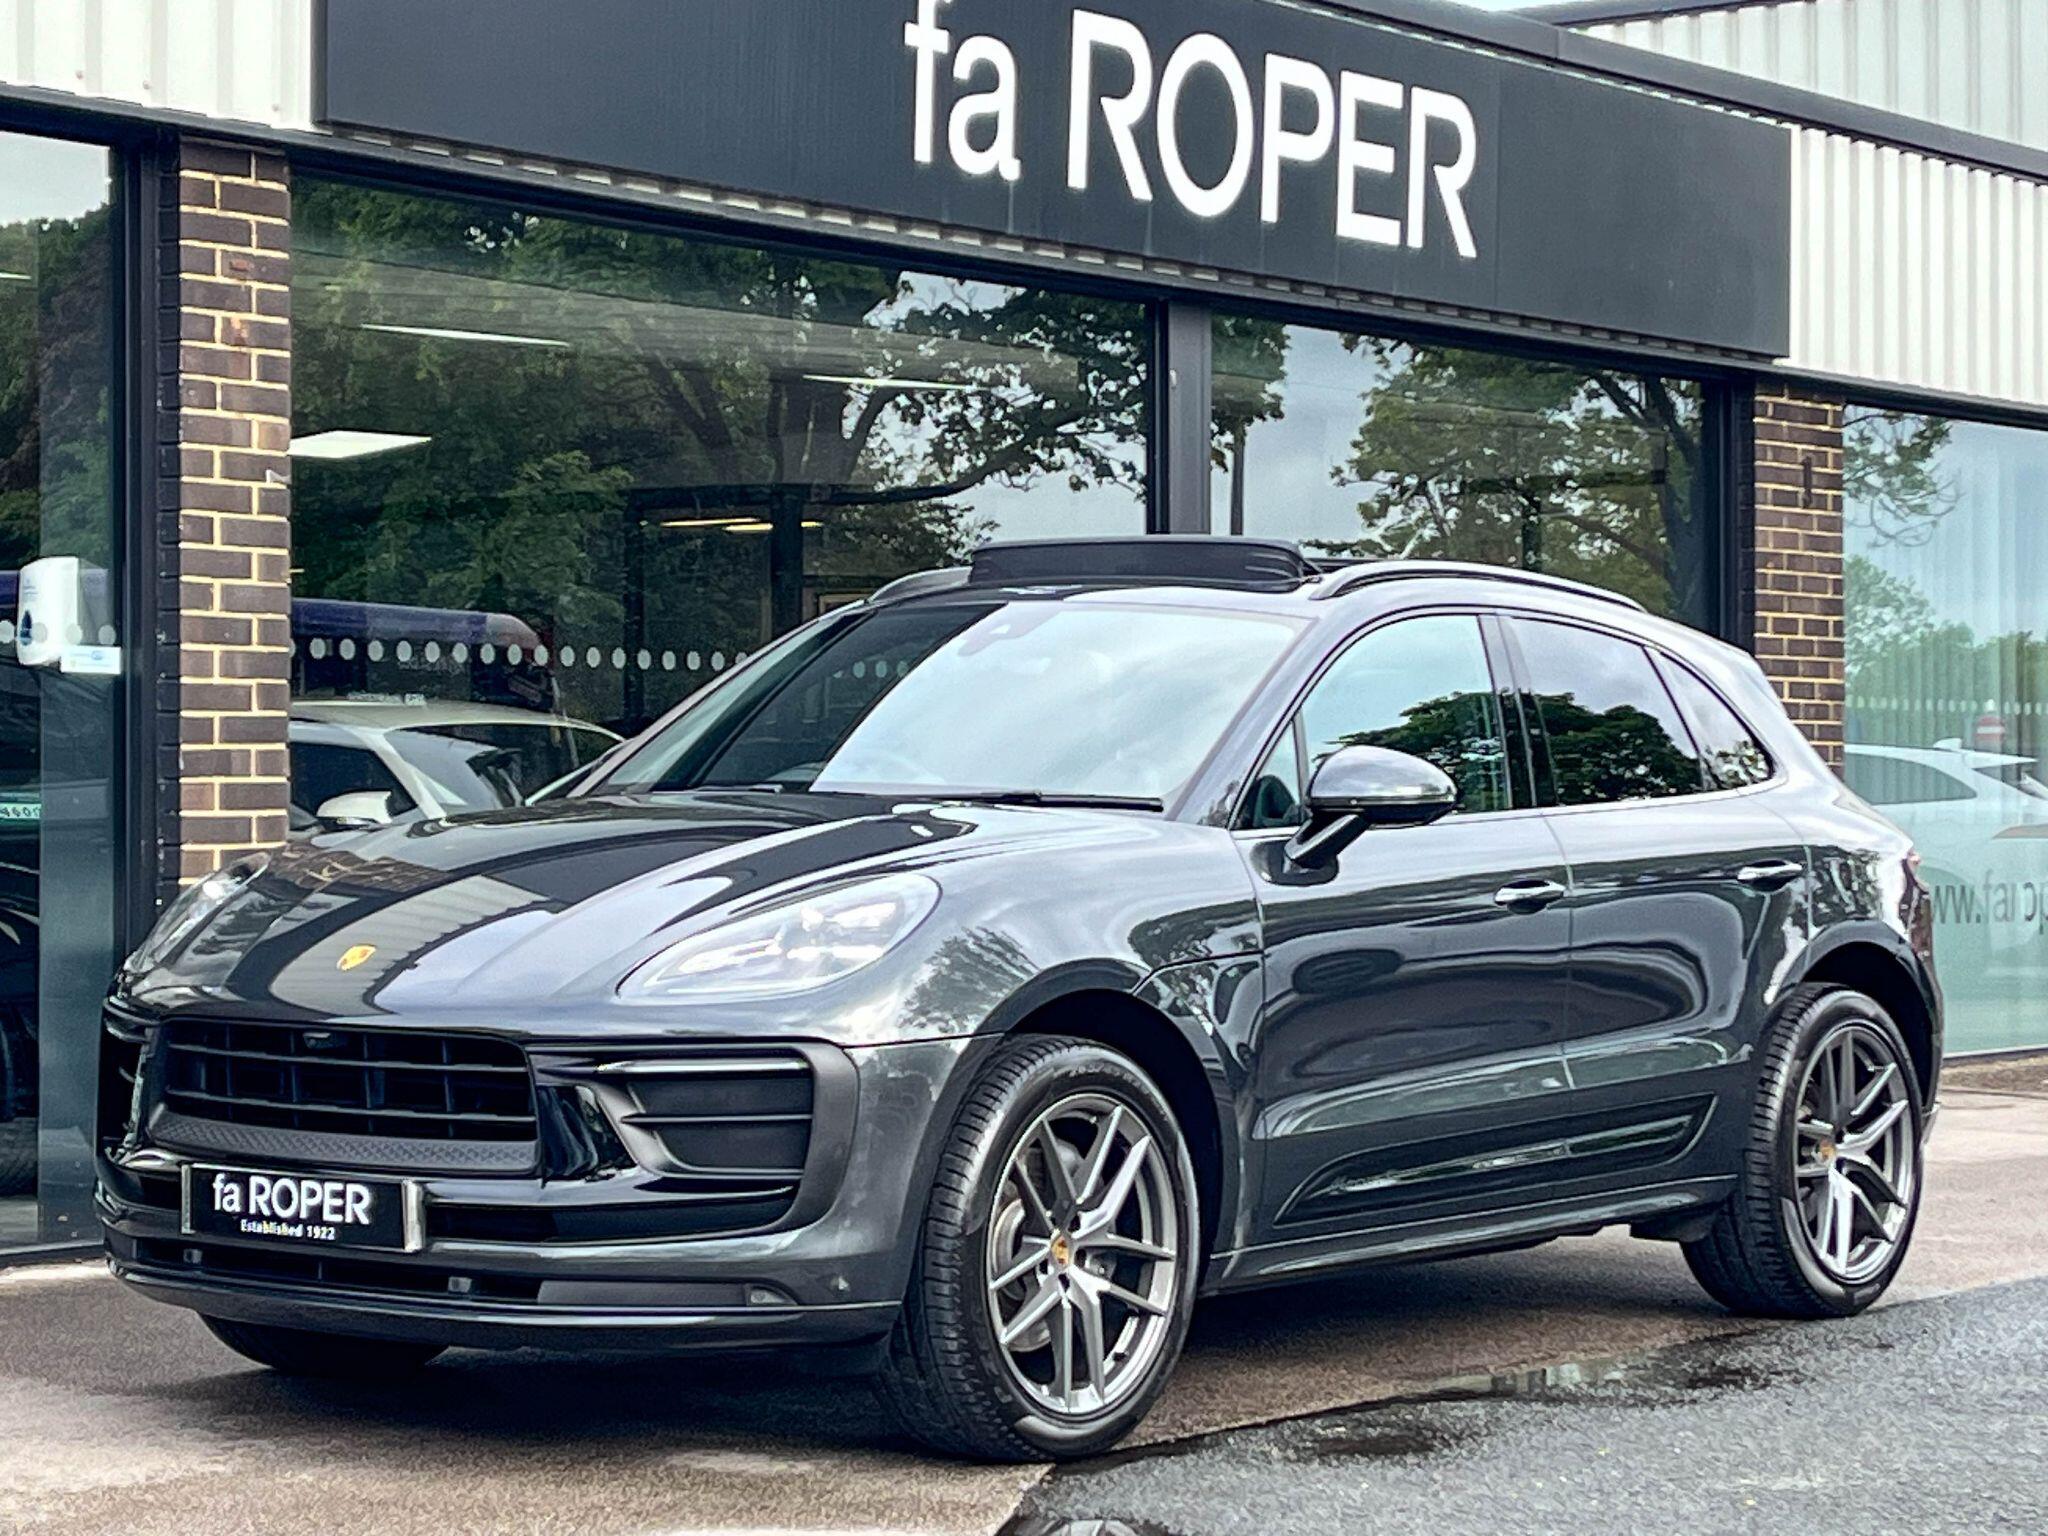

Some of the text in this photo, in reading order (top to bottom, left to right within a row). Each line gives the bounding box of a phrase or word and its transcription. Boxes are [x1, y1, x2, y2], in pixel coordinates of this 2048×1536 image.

[904, 0, 1478, 259] fa ROPER
[212, 1173, 371, 1225] fa ROPER
[240, 1219, 336, 1241] Established 1922
